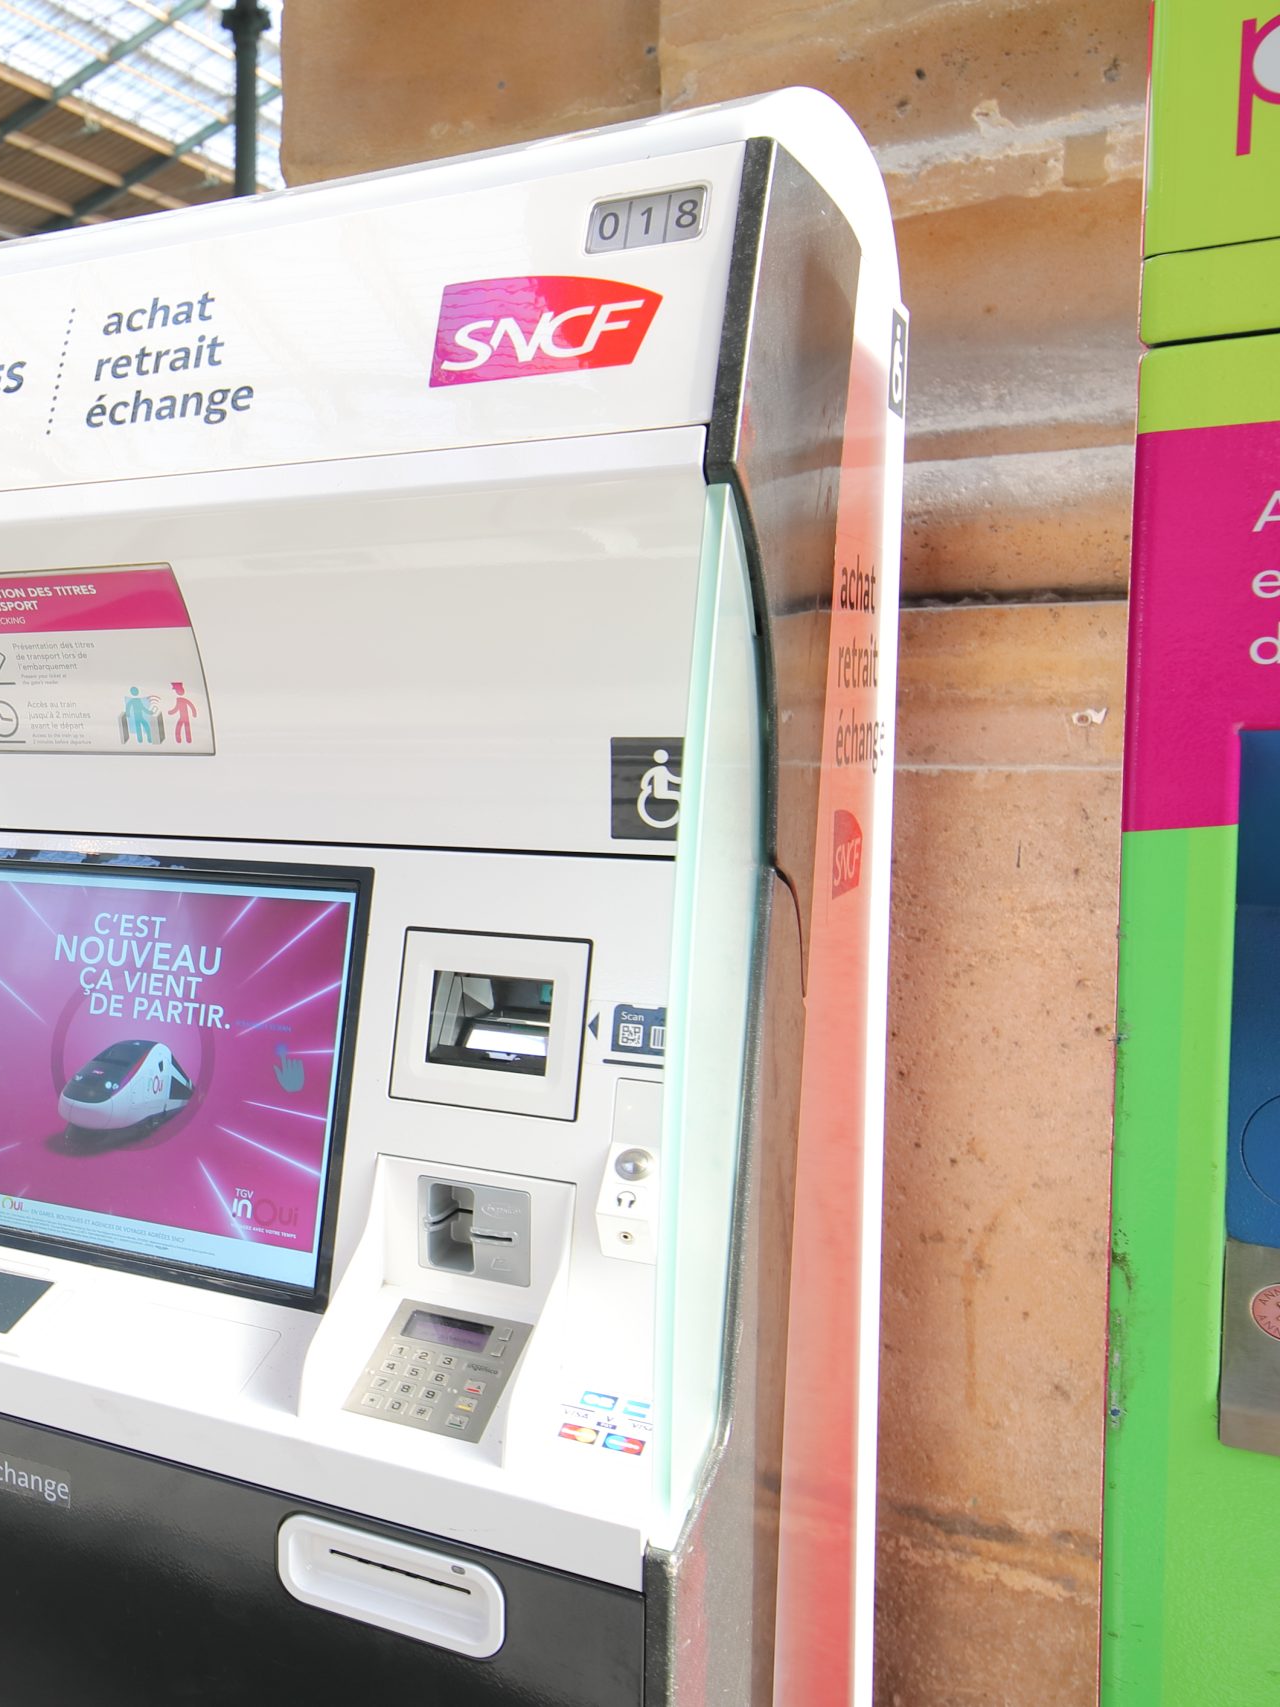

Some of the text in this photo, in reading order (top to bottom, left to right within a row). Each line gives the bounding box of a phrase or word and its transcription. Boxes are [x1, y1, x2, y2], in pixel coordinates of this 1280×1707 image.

[102, 291, 215, 335] achat
[441, 299, 645, 371] SNCF
[94, 335, 225, 382] retrait
[86, 385, 254, 428] échange
[27, 586, 52, 598] DES
[53, 584, 97, 597] TITRES
[840, 553, 876, 614] achat
[12, 643, 59, 651] Présentation
[74, 641, 95, 649] titres
[26, 652, 61, 662] transport
[838, 632, 878, 689] retrait
[27, 700, 48, 708] Accès
[55, 711, 61, 719] 2
[62, 711, 91, 719] minutes
[834, 838, 860, 887] SNCF
[94, 912, 166, 939] C'EST
[54, 934, 222, 976] NOUVEAU
[79, 967, 203, 1000] ÇA VIENT
[89, 993, 125, 1018] DE
[133, 997, 231, 1030] PARTIR.
[621, 1011, 645, 1022] Scan
[235, 1187, 254, 1199] TGV
[397, 1347, 453, 1366] 1 2 3
[386, 1362, 444, 1382] 4 5 6
[378, 1379, 436, 1399] 7 8 9
[391, 1401, 401, 1410] 0
